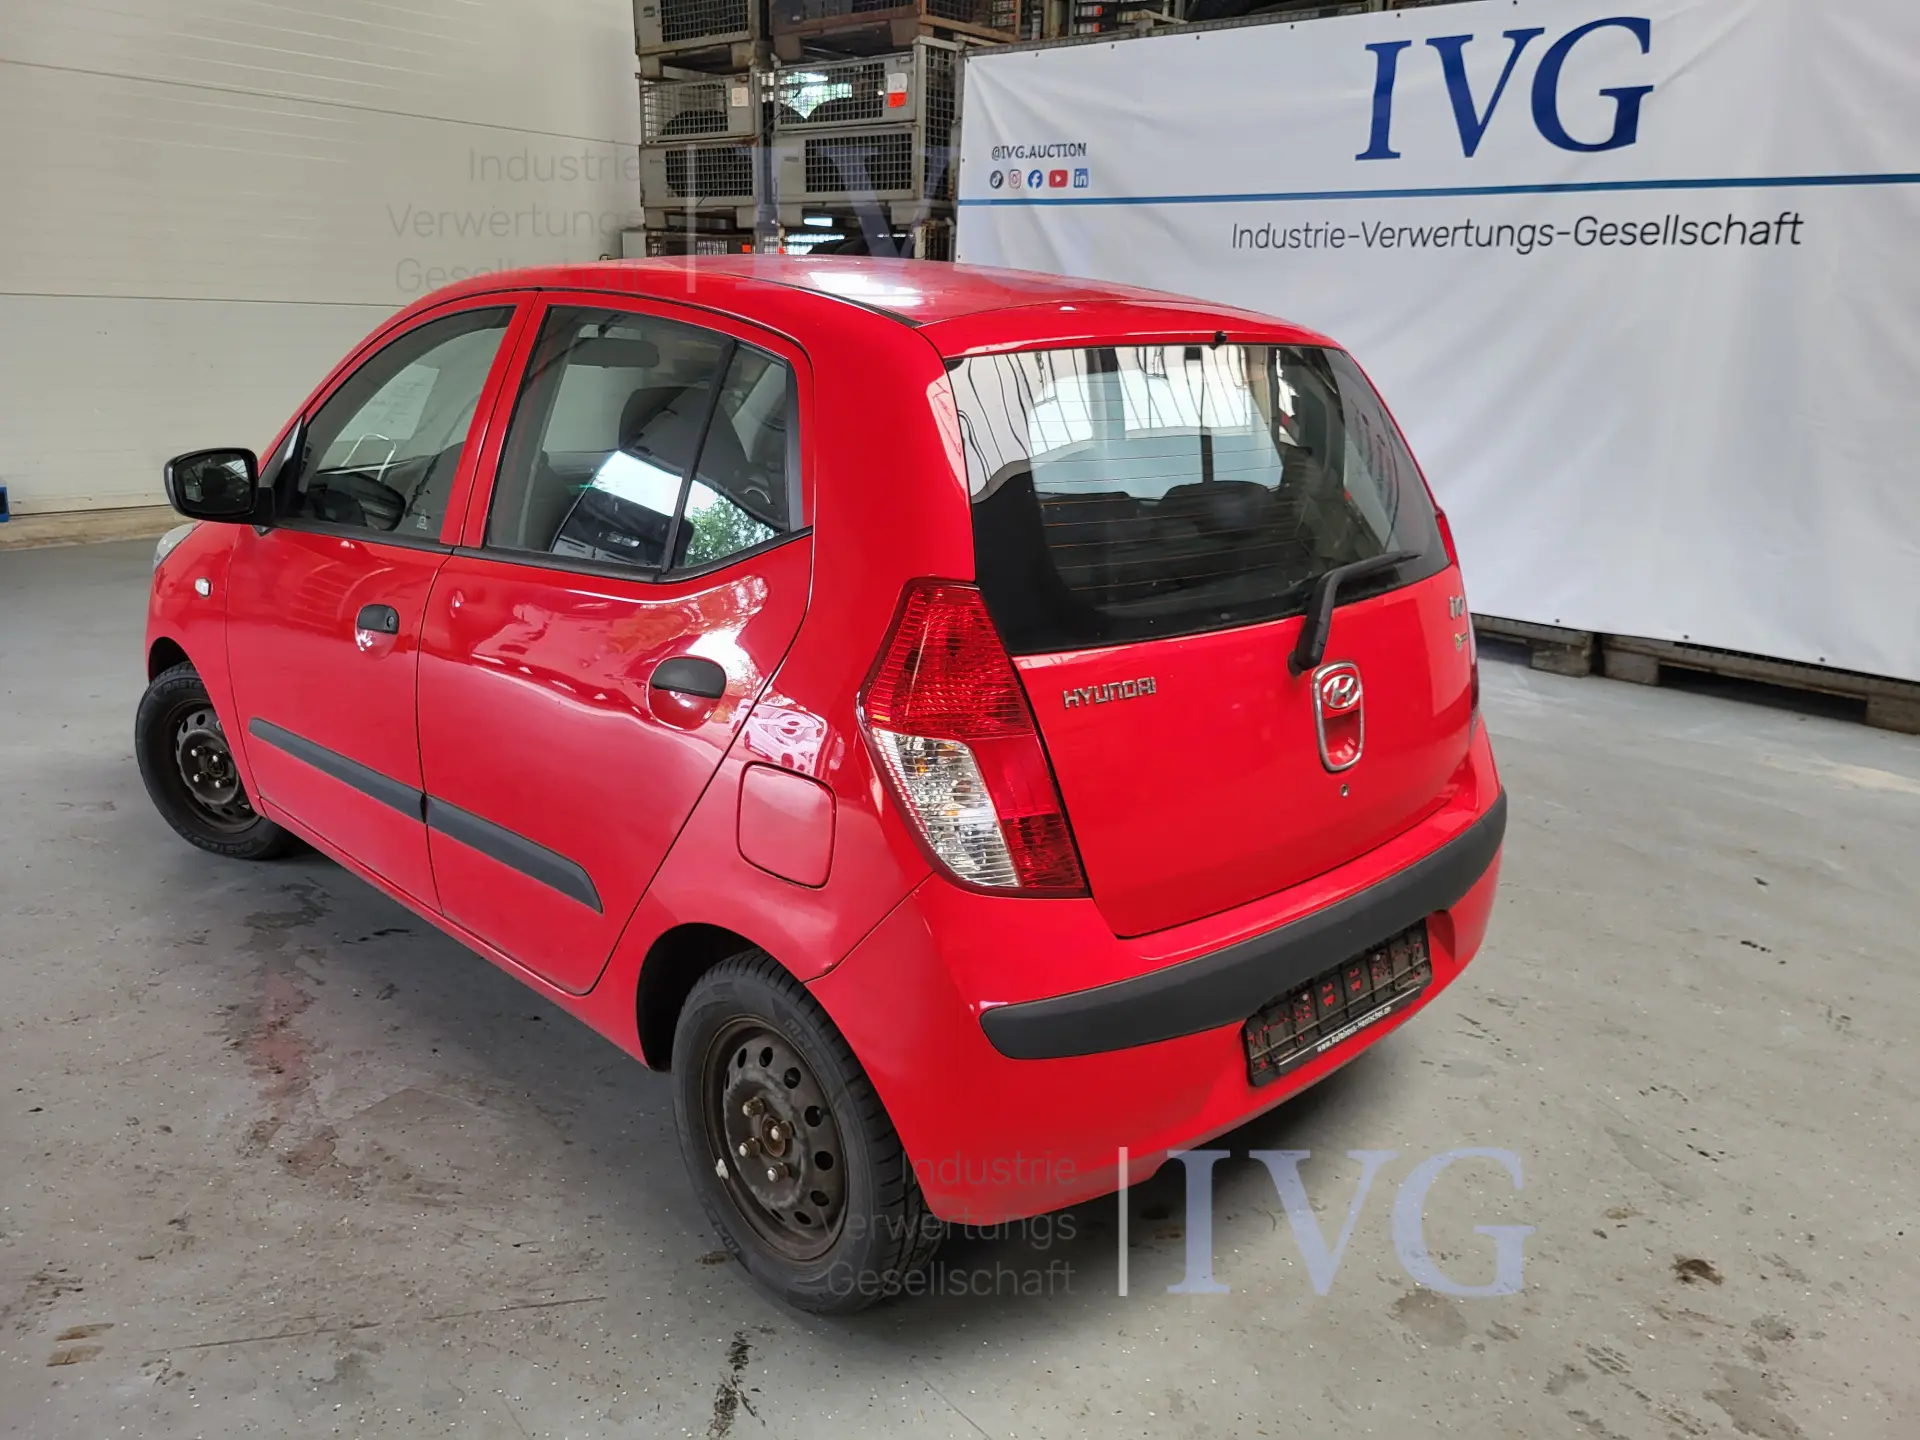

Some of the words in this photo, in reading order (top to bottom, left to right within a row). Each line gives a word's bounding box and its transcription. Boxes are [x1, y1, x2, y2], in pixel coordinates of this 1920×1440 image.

[1355, 17, 1653, 161] IVG
[991, 142, 1087, 161] @IVG.AUCTION
[1231, 211, 1804, 255] Industrie-Verwertungs-Gesellschaft
[1063, 676, 1156, 709] HYUNDAI
